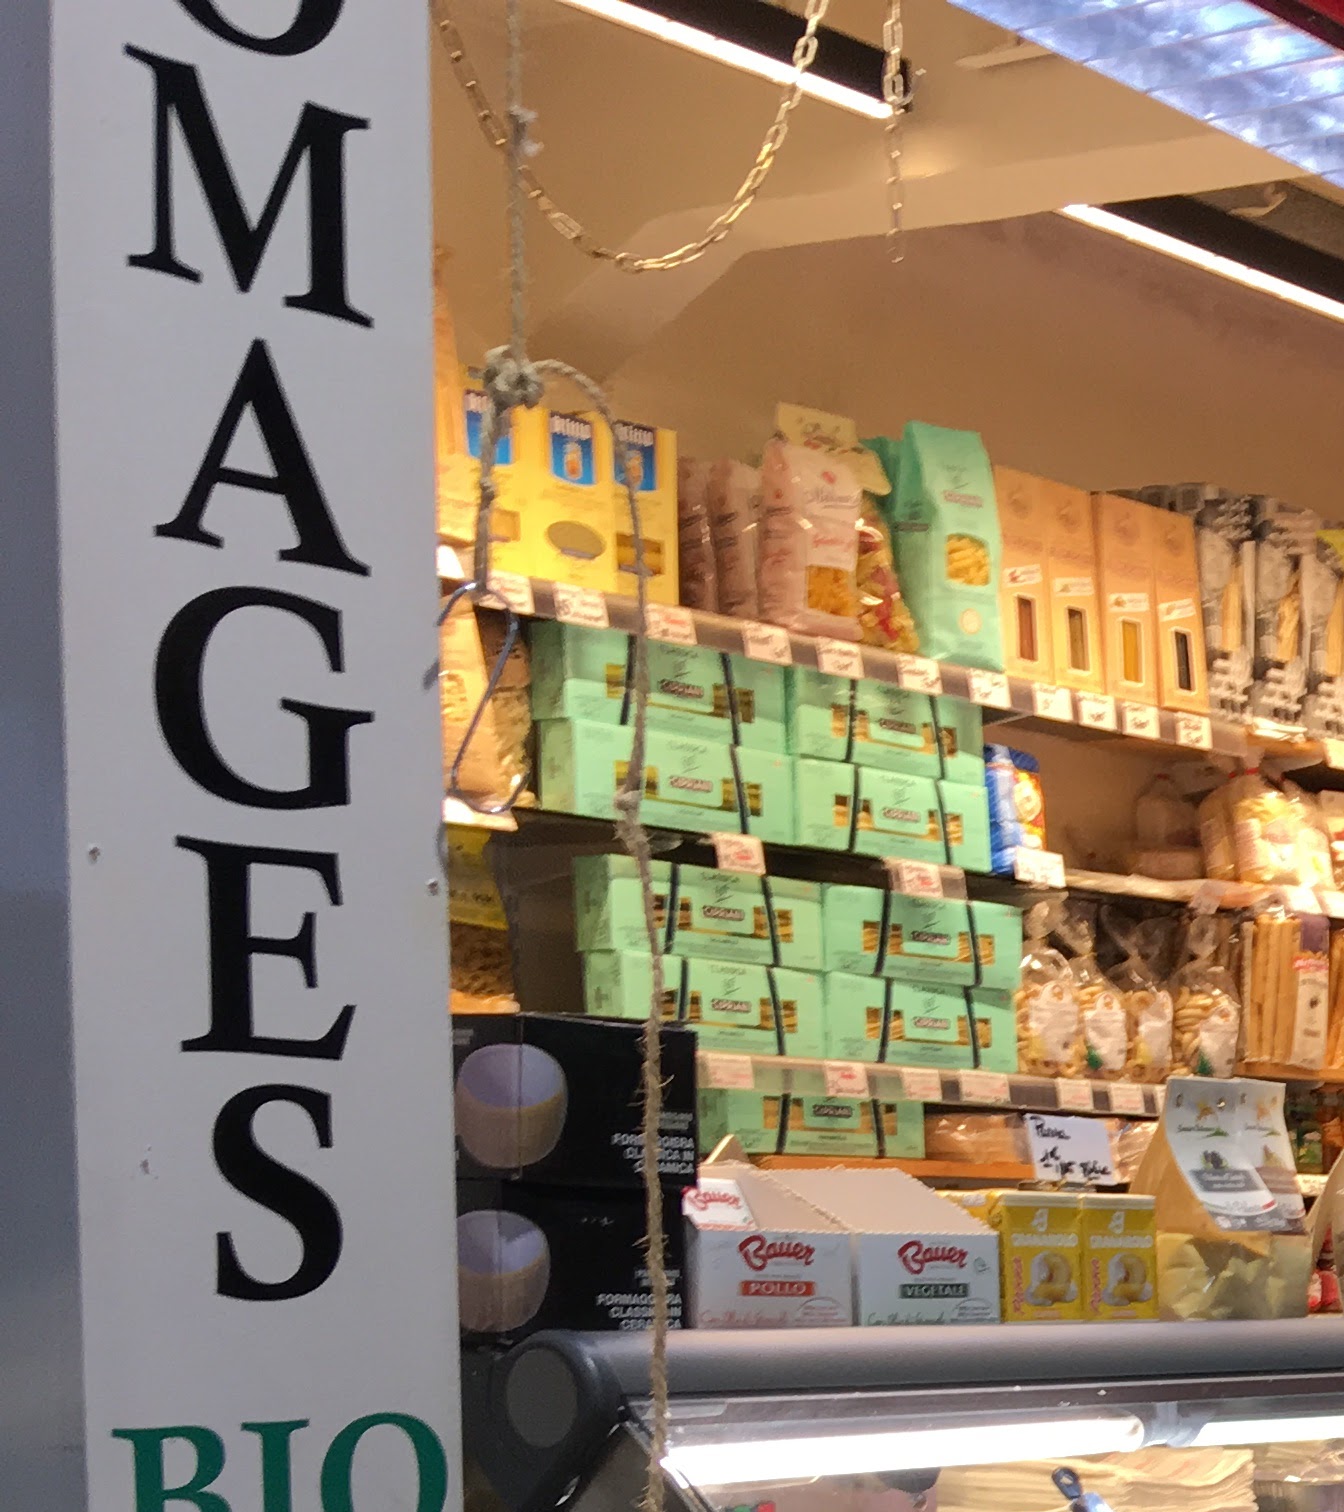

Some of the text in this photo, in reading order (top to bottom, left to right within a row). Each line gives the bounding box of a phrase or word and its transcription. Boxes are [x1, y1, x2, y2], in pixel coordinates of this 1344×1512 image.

[738, 1234, 816, 1272] Bauer
[898, 1240, 969, 1275] Bauer
[749, 1282, 807, 1296] POLLO
[905, 1285, 967, 1297] VEGETALE
